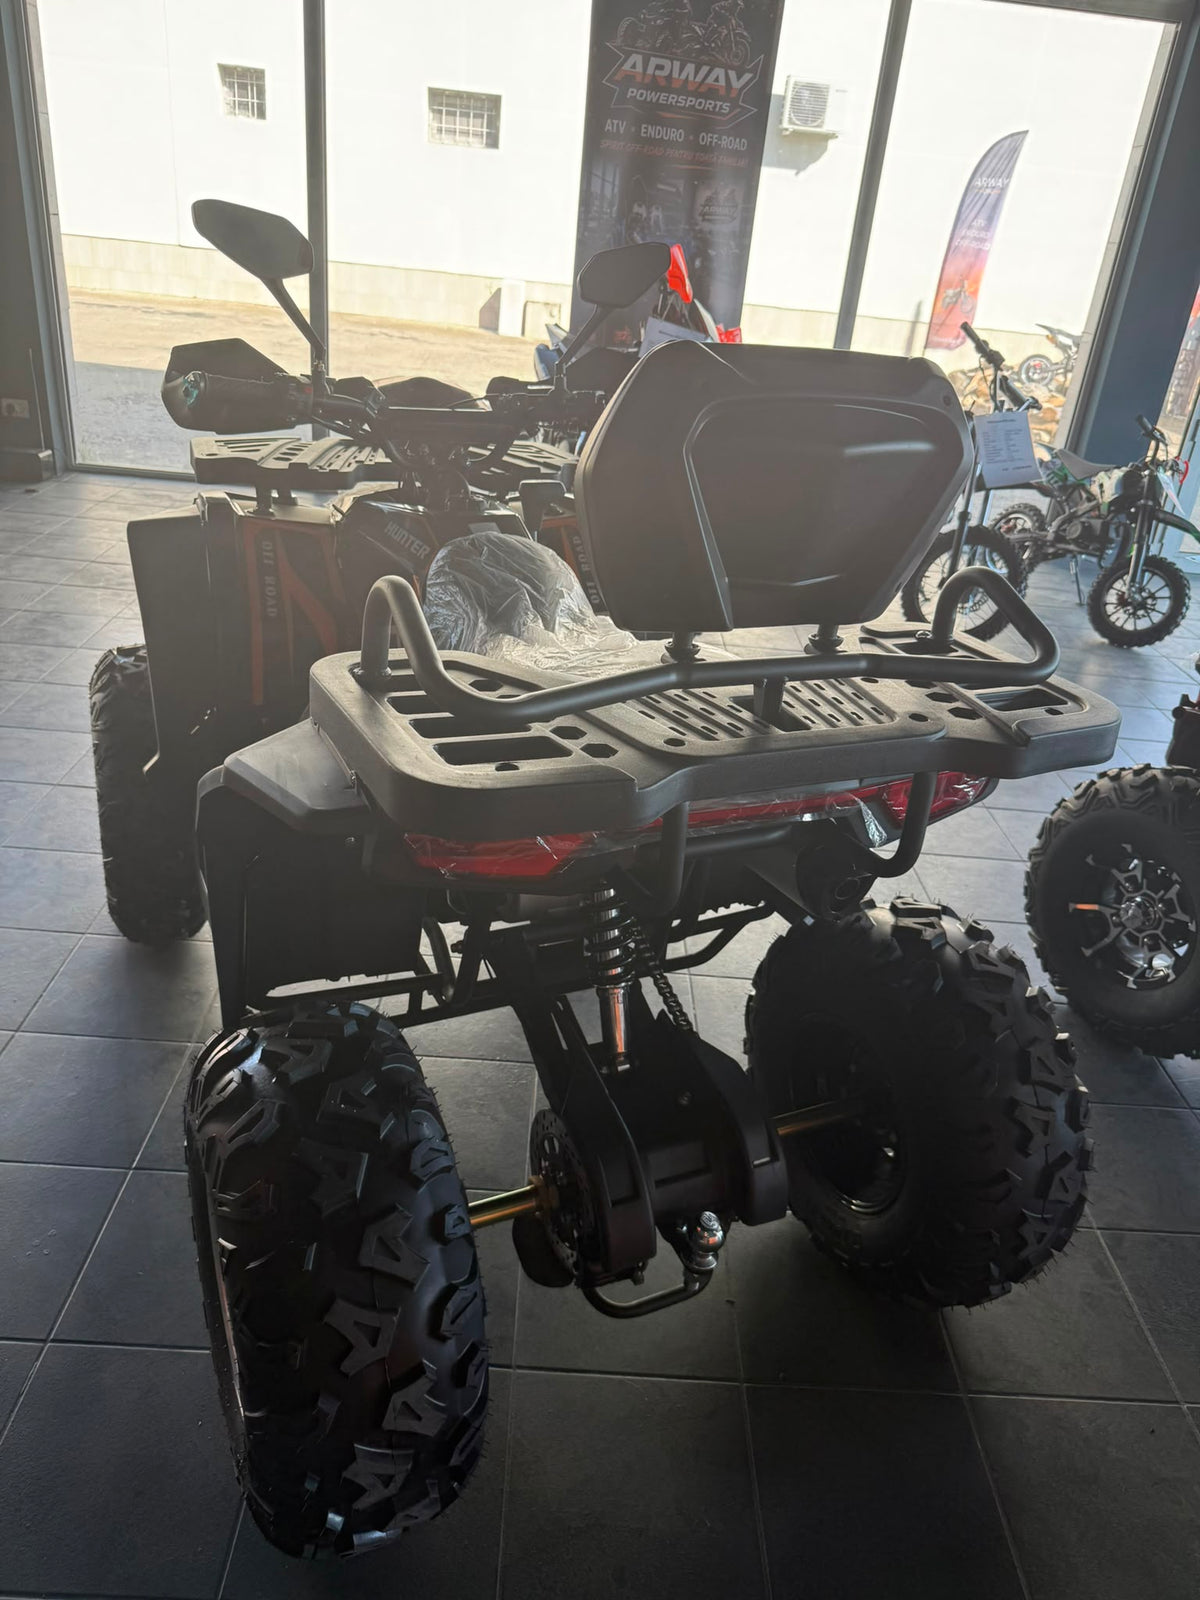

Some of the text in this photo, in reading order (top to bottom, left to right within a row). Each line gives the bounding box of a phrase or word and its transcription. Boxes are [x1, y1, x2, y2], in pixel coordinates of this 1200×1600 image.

[613, 53, 753, 98] ARWAY
[627, 87, 731, 114] POWERSPORTS
[605, 118, 749, 151] ATV ENDURO OFF-ROAD
[384, 521, 431, 560] HUNTER
[262, 575, 278, 617] ROAD
